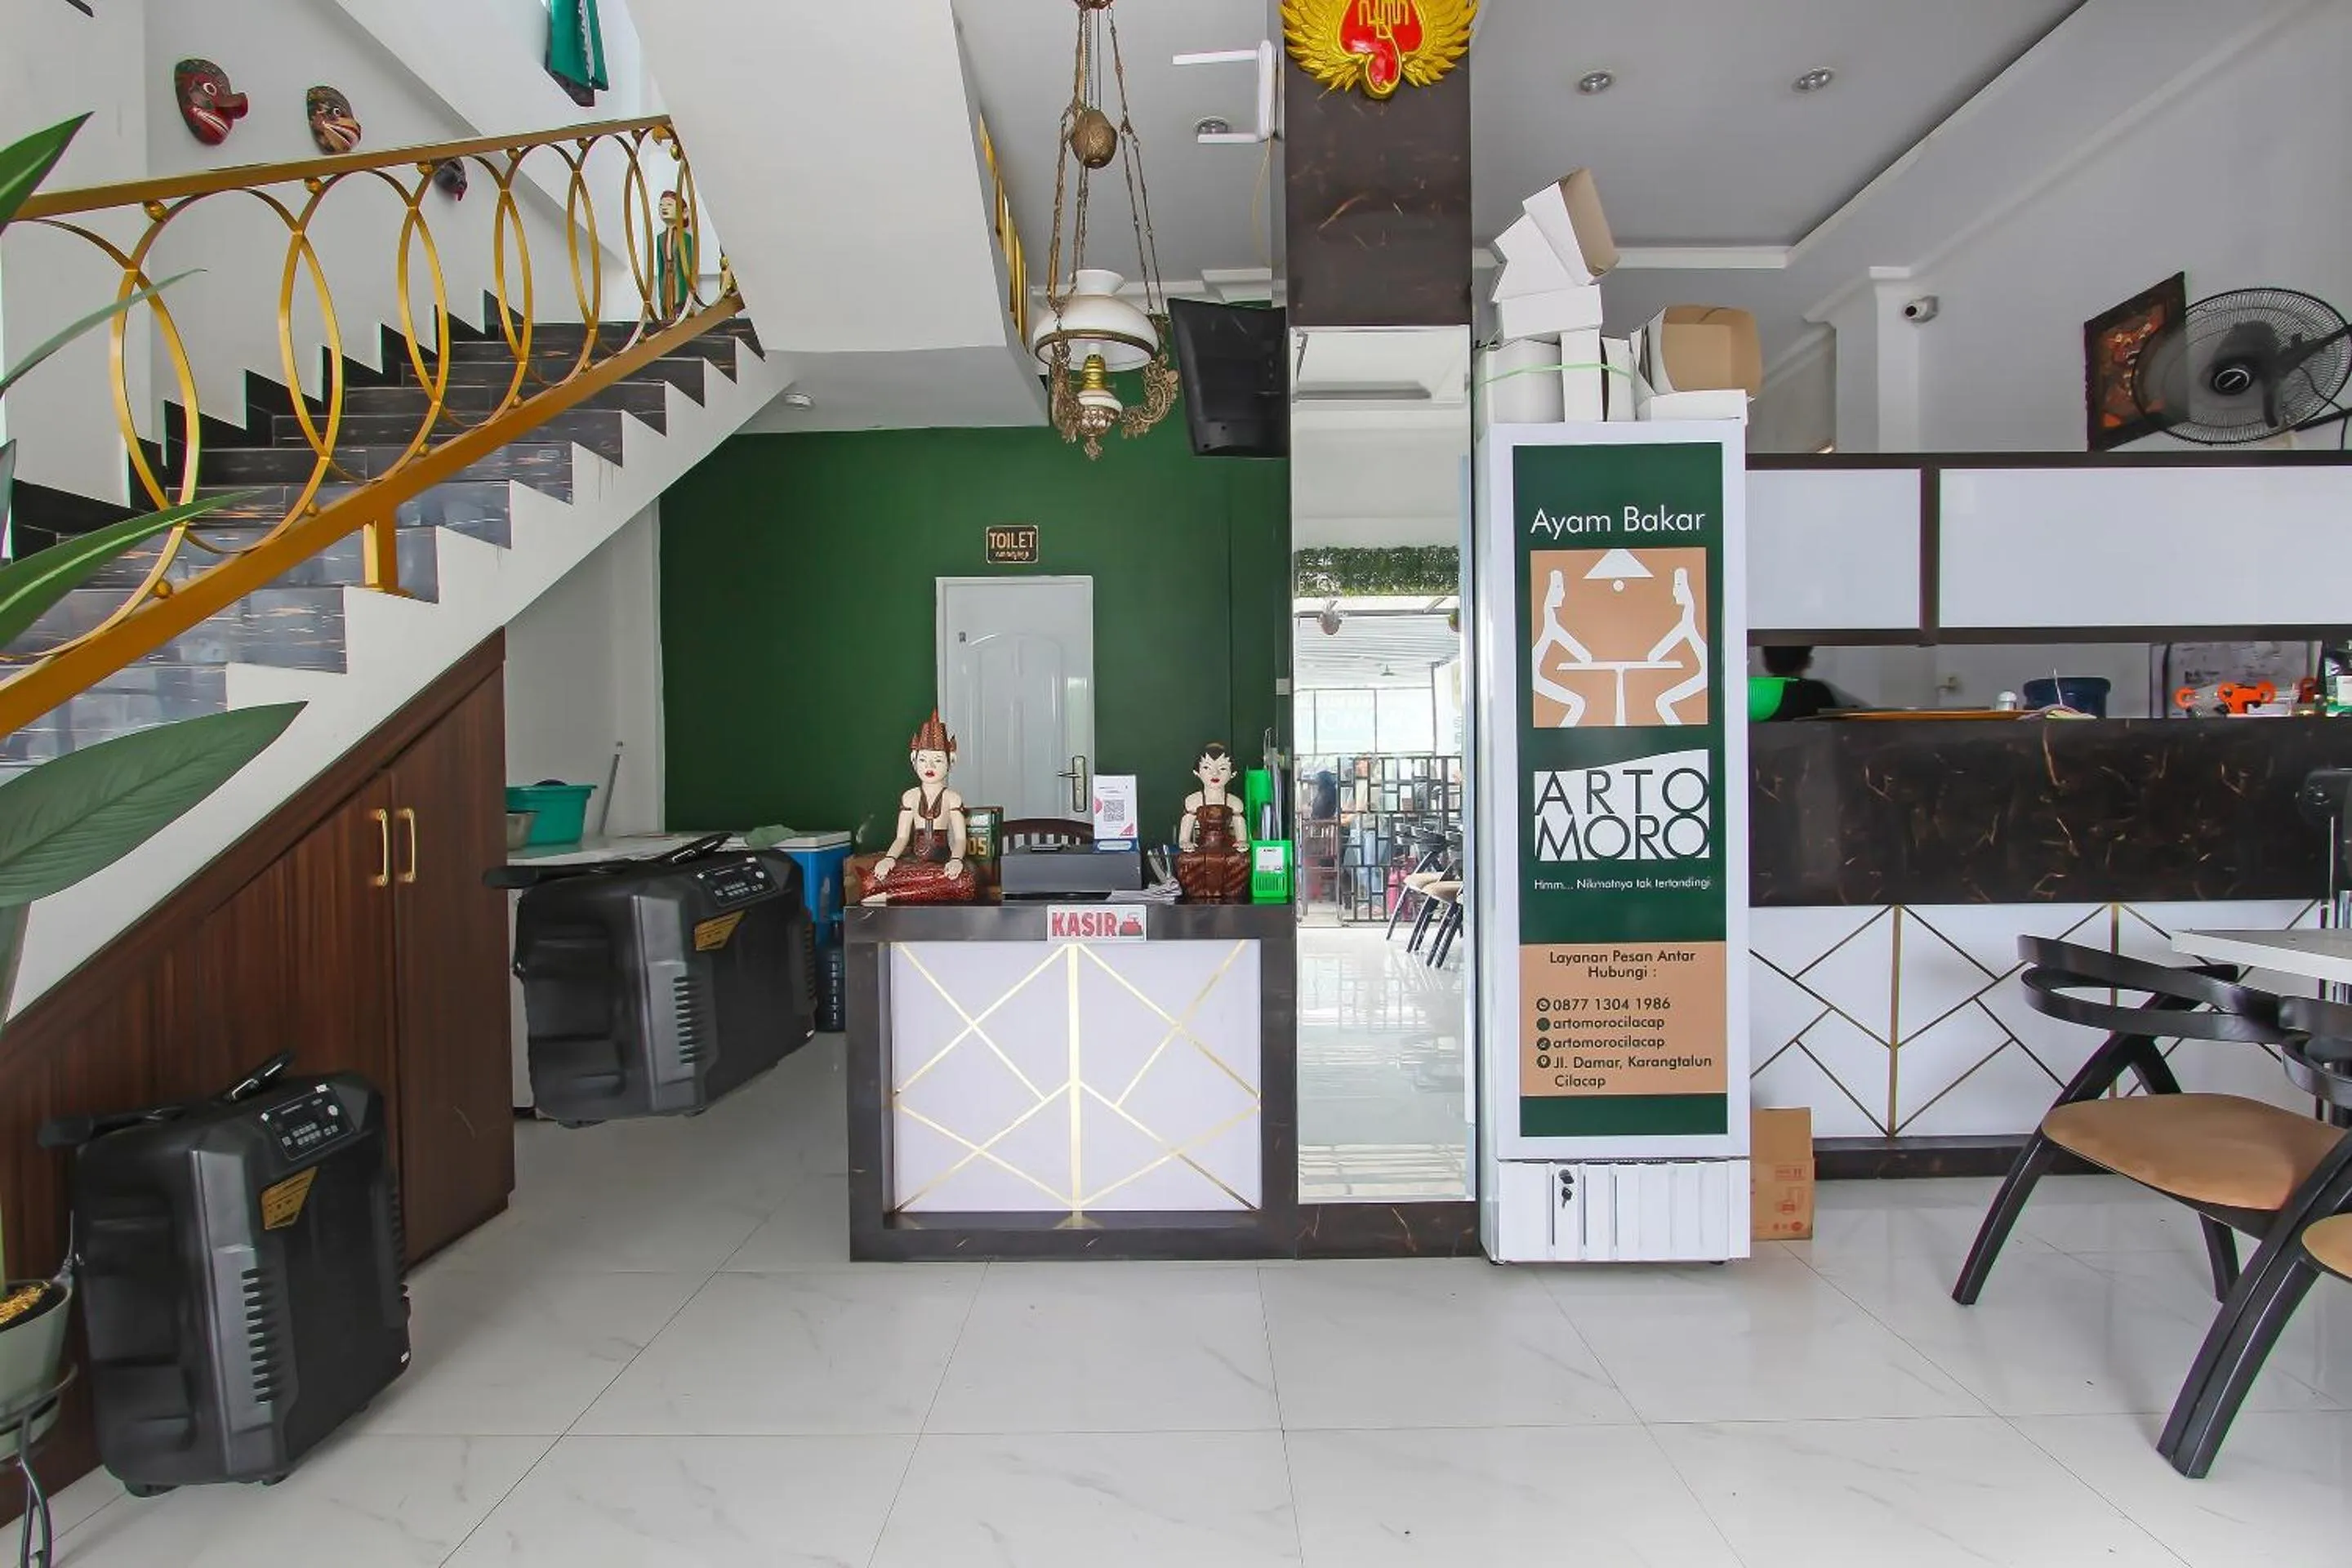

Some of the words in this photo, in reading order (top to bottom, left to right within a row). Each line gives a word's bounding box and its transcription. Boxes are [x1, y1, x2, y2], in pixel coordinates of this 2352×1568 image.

[1530, 507, 1611, 540] Ayam
[1624, 504, 1706, 532] Bakar
[989, 531, 1036, 549] TOILET
[1535, 768, 1710, 815] ARTO
[1536, 815, 1710, 862] MORO
[1534, 879, 1575, 890] Hmm...
[1576, 878, 1633, 892] Nikmatnya
[1636, 877, 1652, 889] tak
[1052, 911, 1117, 937] KASIR
[1550, 951, 1608, 966] Layanan
[1613, 950, 1653, 962] Pesan
[1657, 950, 1696, 962] Antar
[1588, 966, 1647, 981] Hubungi
[1553, 998, 1589, 1011] 0877
[1595, 998, 1630, 1010] 1304
[1636, 997, 1671, 1010] 1986
[1553, 1016, 1665, 1031] artomorocilacap
[1553, 1035, 1665, 1049] artomorocilacap
[1553, 1057, 1568, 1069] Jl.
[1573, 1057, 1623, 1070] Damar,
[1628, 1055, 1713, 1070] Karangtalun
[1554, 1075, 1606, 1089] Cilacap
